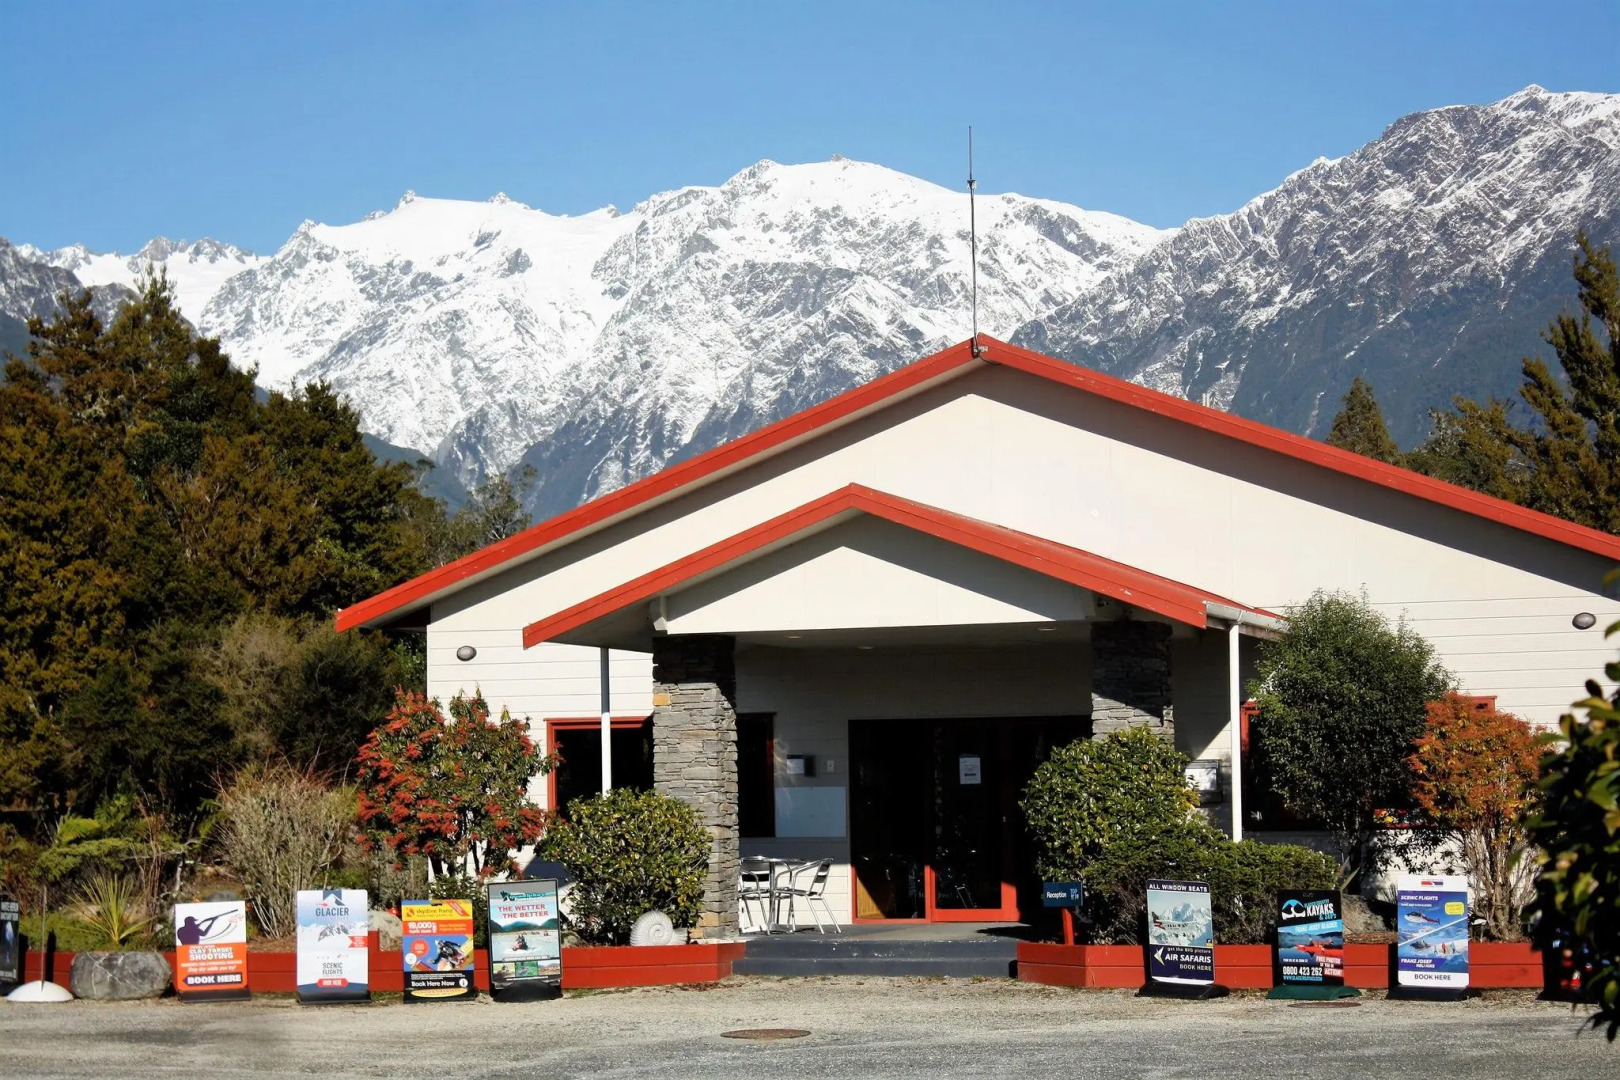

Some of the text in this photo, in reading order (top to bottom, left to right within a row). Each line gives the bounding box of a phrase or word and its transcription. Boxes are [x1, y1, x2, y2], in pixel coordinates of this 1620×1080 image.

[316, 907, 350, 916] GLACIER
[1306, 903, 1334, 916] KAYAKS
[190, 952, 234, 960] SHOOTING
[1180, 954, 1212, 964] SAFARIS
[1282, 966, 1322, 976] 0800 423 262
[187, 974, 242, 984] BOOK HERE
